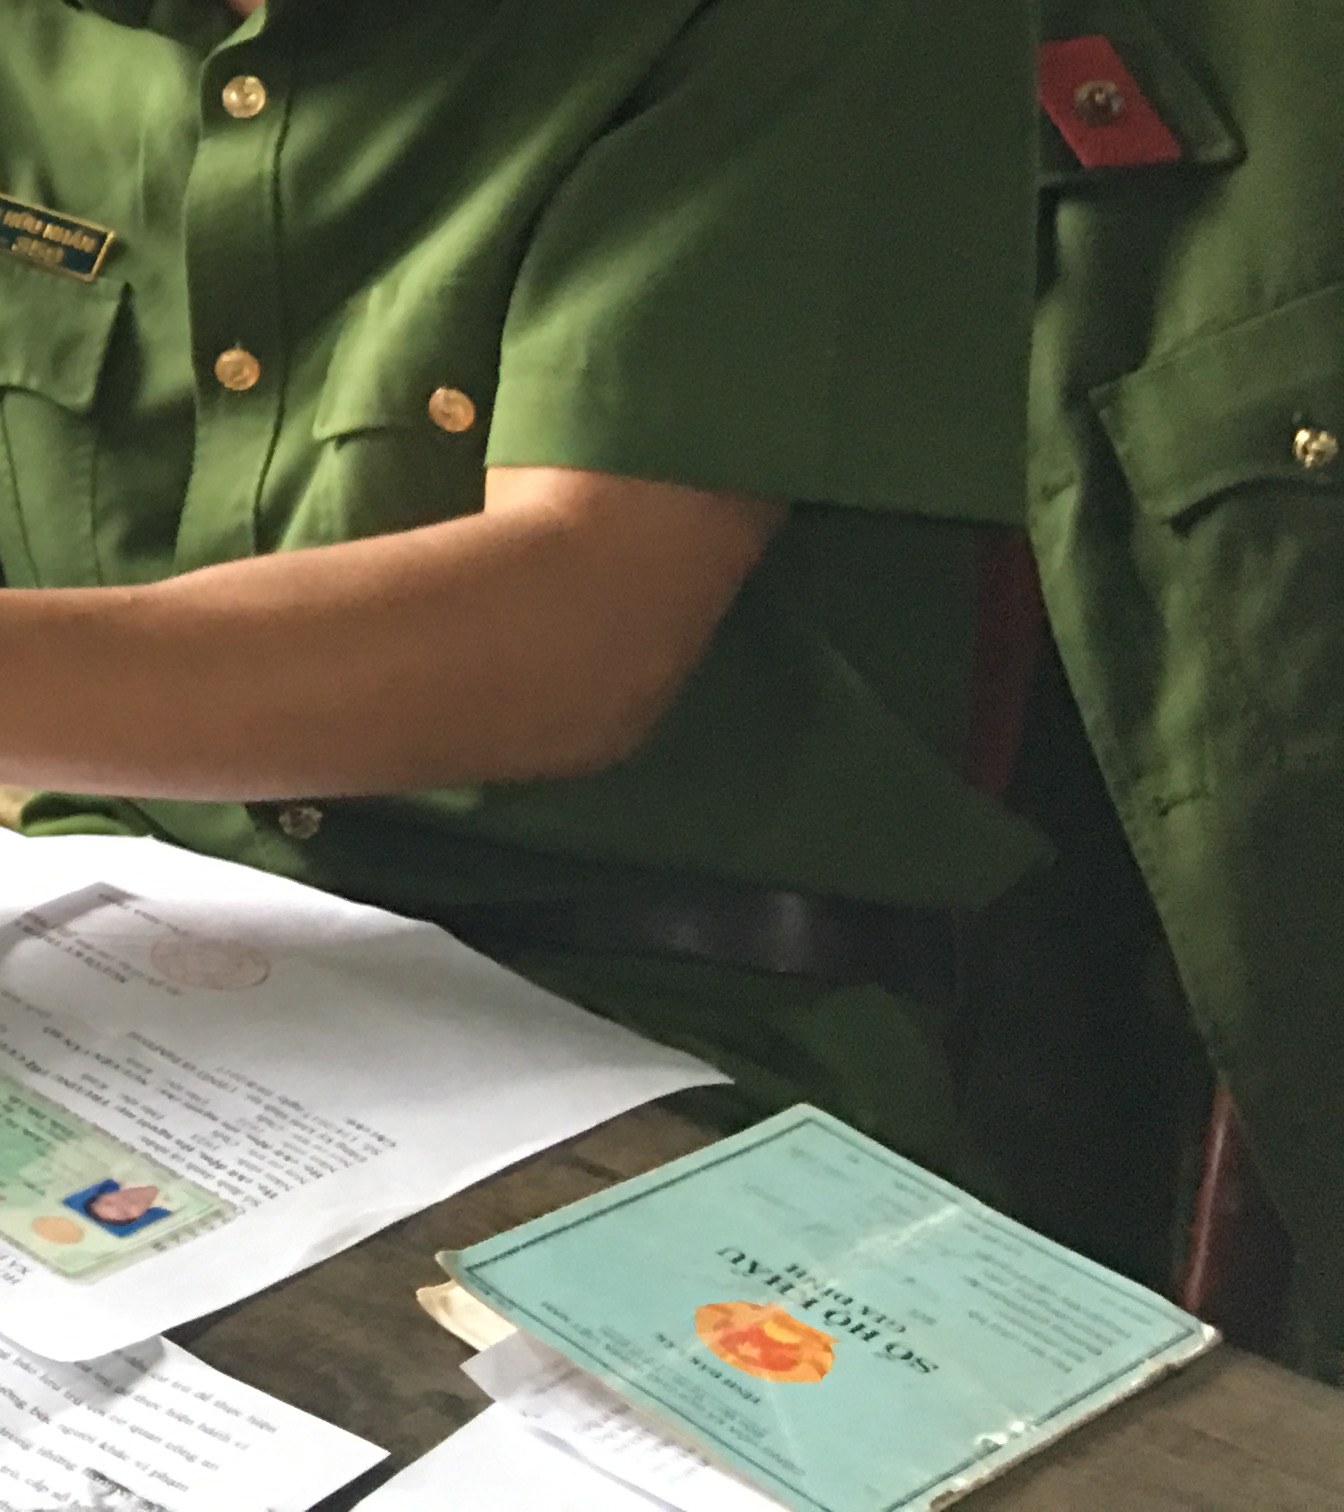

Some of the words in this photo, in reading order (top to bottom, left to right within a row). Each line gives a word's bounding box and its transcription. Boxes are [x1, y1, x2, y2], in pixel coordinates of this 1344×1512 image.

[824, 1310, 879, 1341] HỘ
[861, 1306, 906, 1333] GIA
[882, 1343, 938, 1373] SỔ
